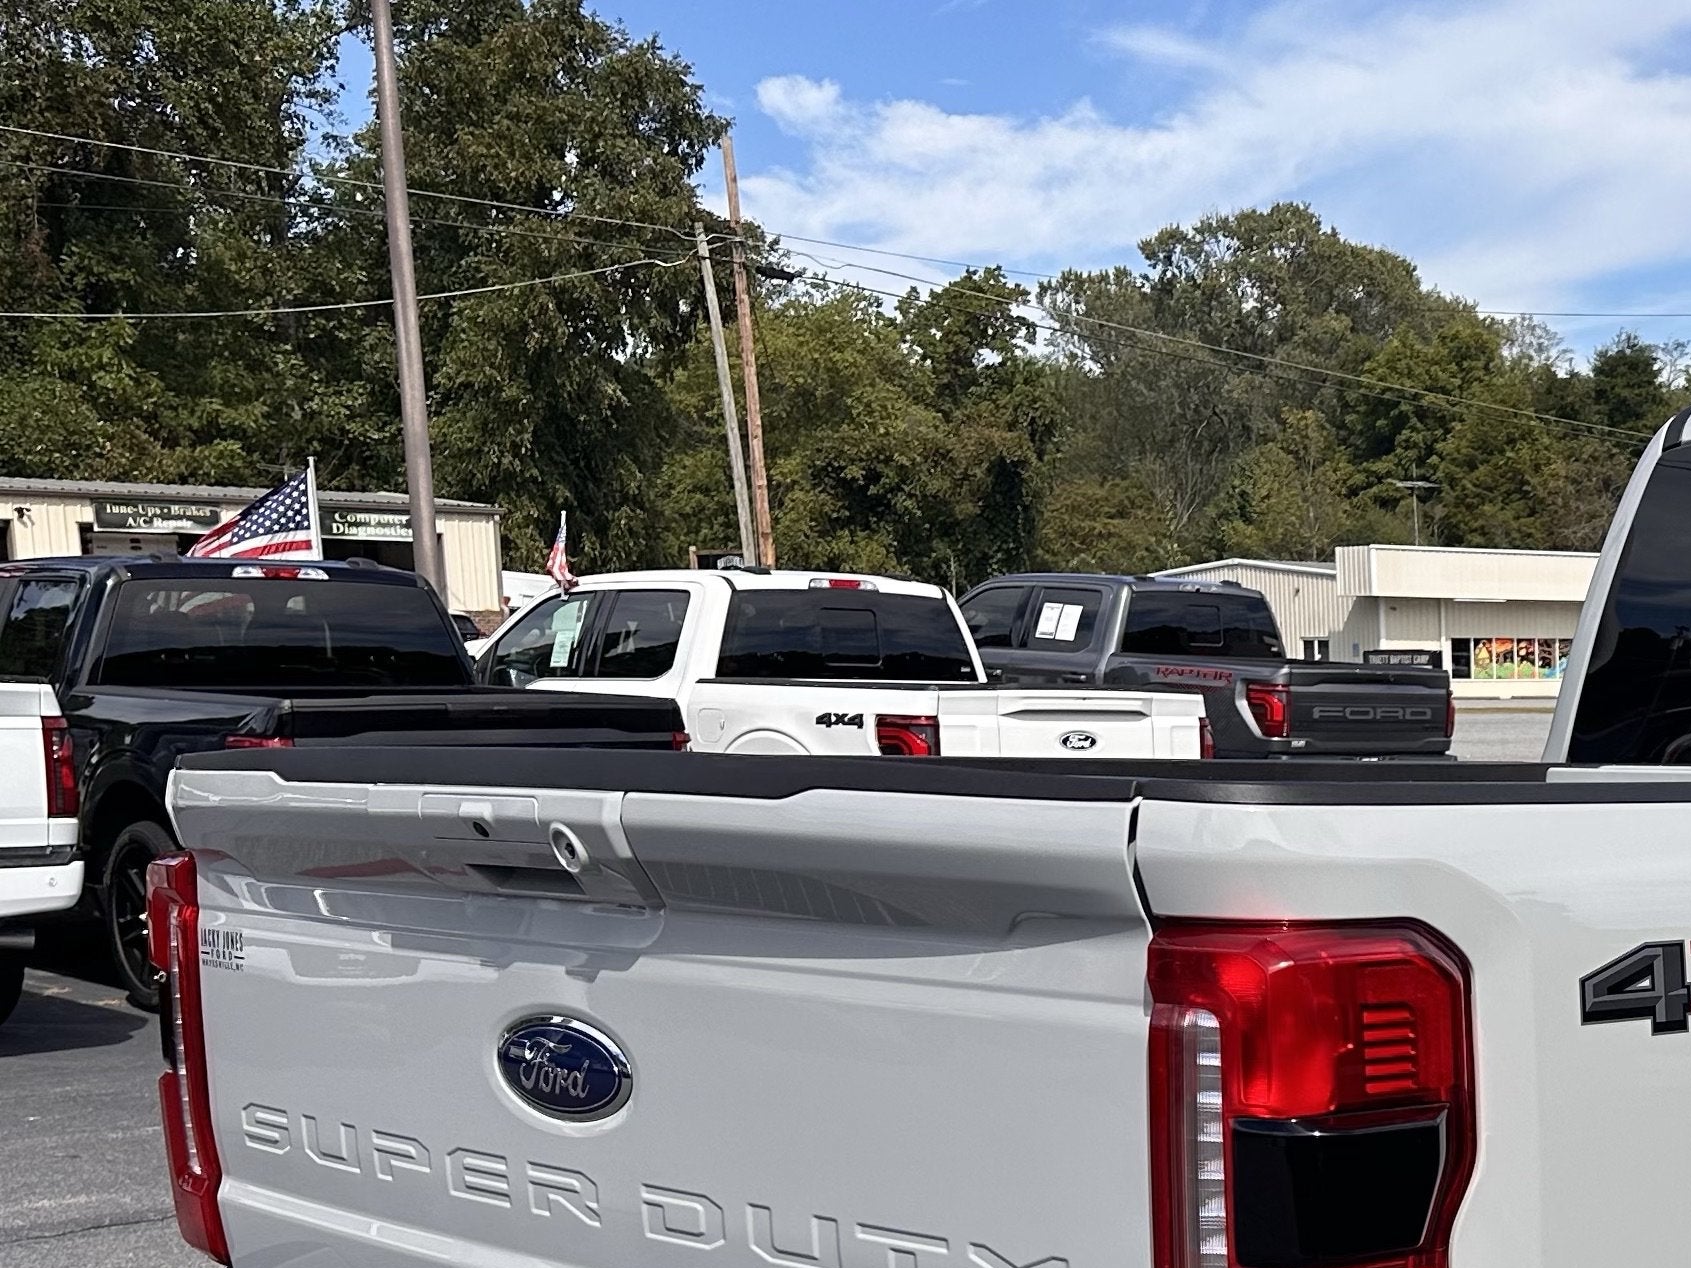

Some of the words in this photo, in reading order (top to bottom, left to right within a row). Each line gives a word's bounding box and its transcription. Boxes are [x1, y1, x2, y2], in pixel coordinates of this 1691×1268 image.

[125, 516, 150, 528] A/C
[153, 518, 194, 529] Repair
[334, 511, 411, 526] Computer
[1312, 706, 1432, 720] FORD
[519, 1036, 590, 1099] Ford
[241, 1101, 602, 1228] SUPER
